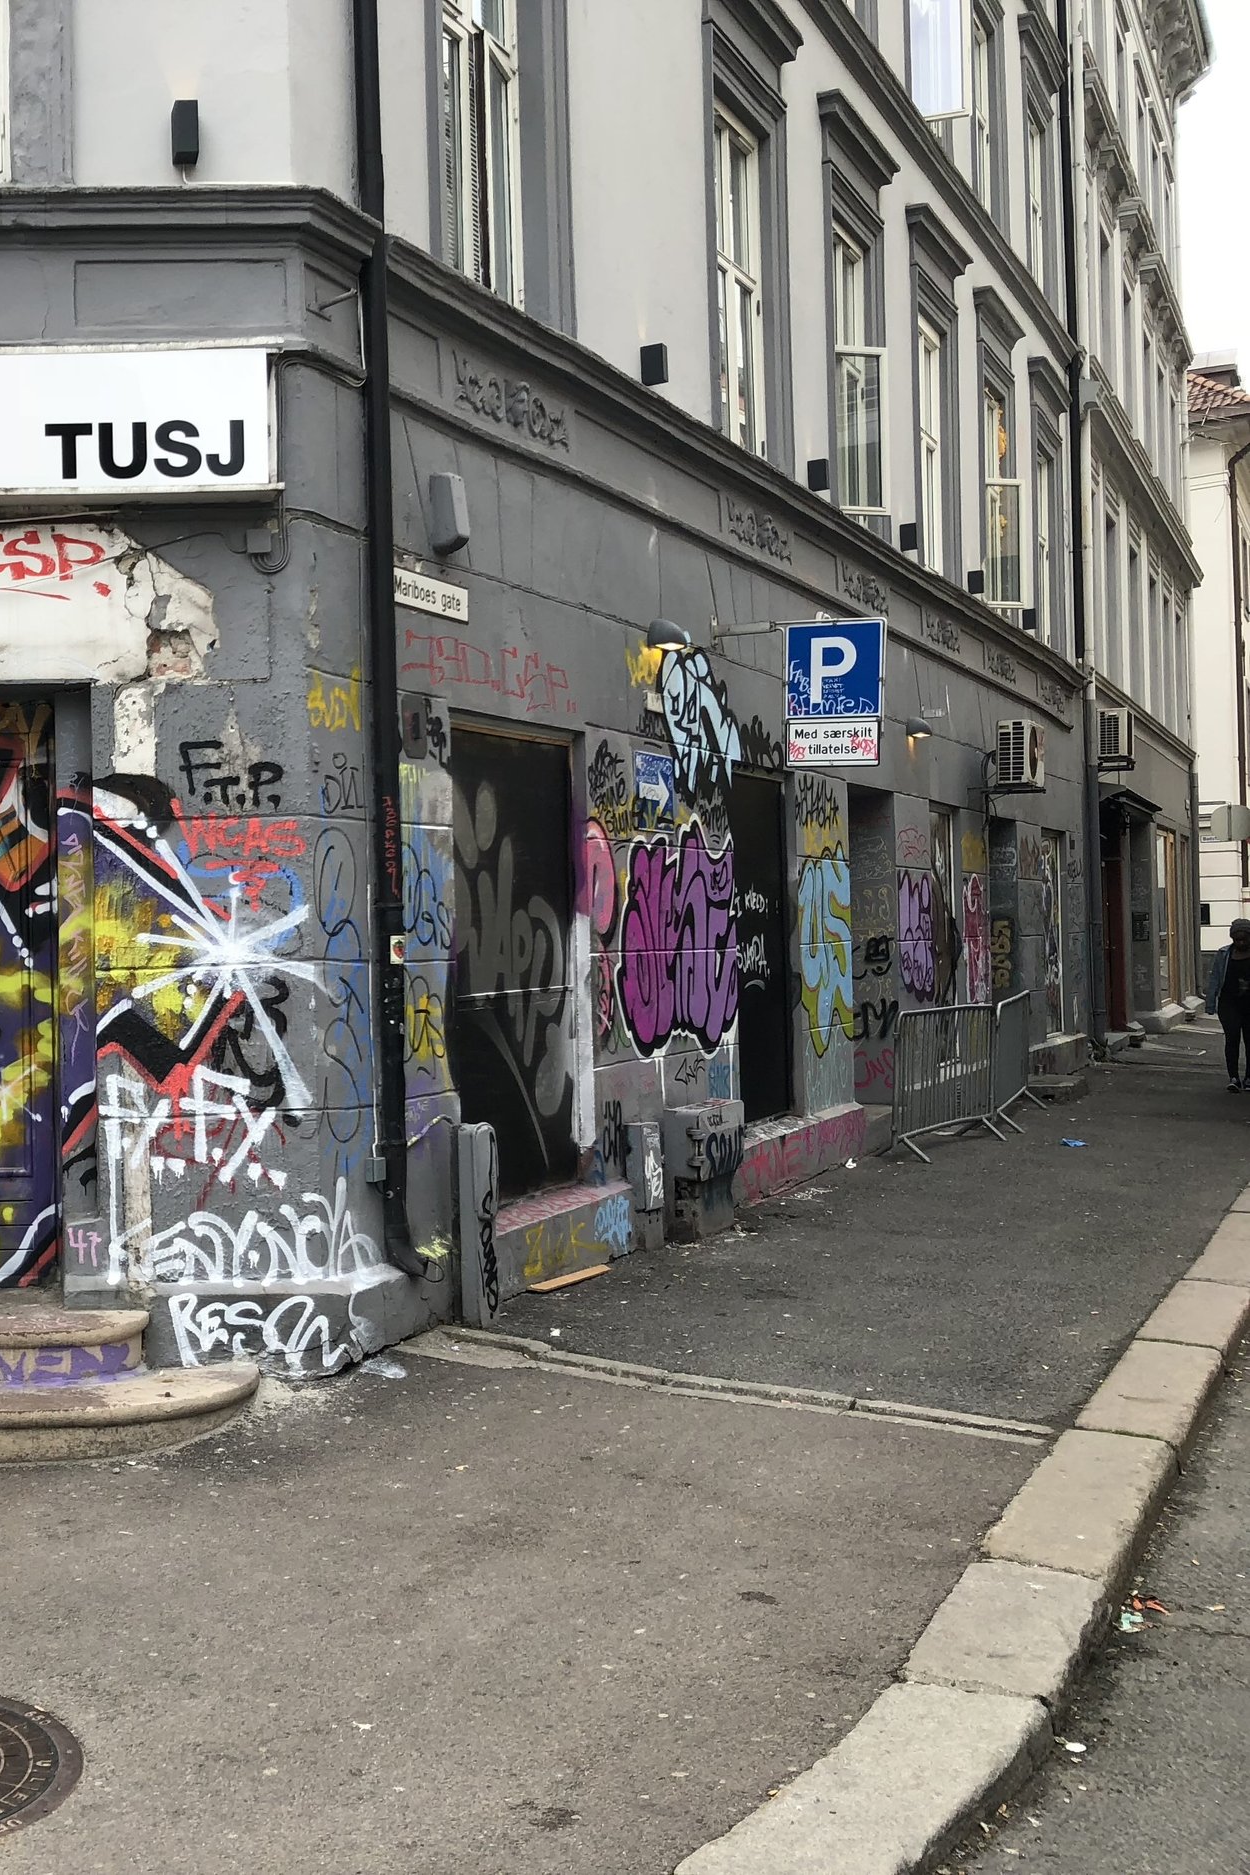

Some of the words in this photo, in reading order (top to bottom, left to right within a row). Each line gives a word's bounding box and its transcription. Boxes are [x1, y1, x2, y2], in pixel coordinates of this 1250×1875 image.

[44, 419, 245, 480] TUSJ
[394, 575, 436, 604] Mariboes
[441, 593, 461, 612] gate
[811, 637, 856, 703] P
[795, 729, 817, 739] Med
[824, 727, 872, 739] særskilt
[808, 744, 858, 754] tillatelse
